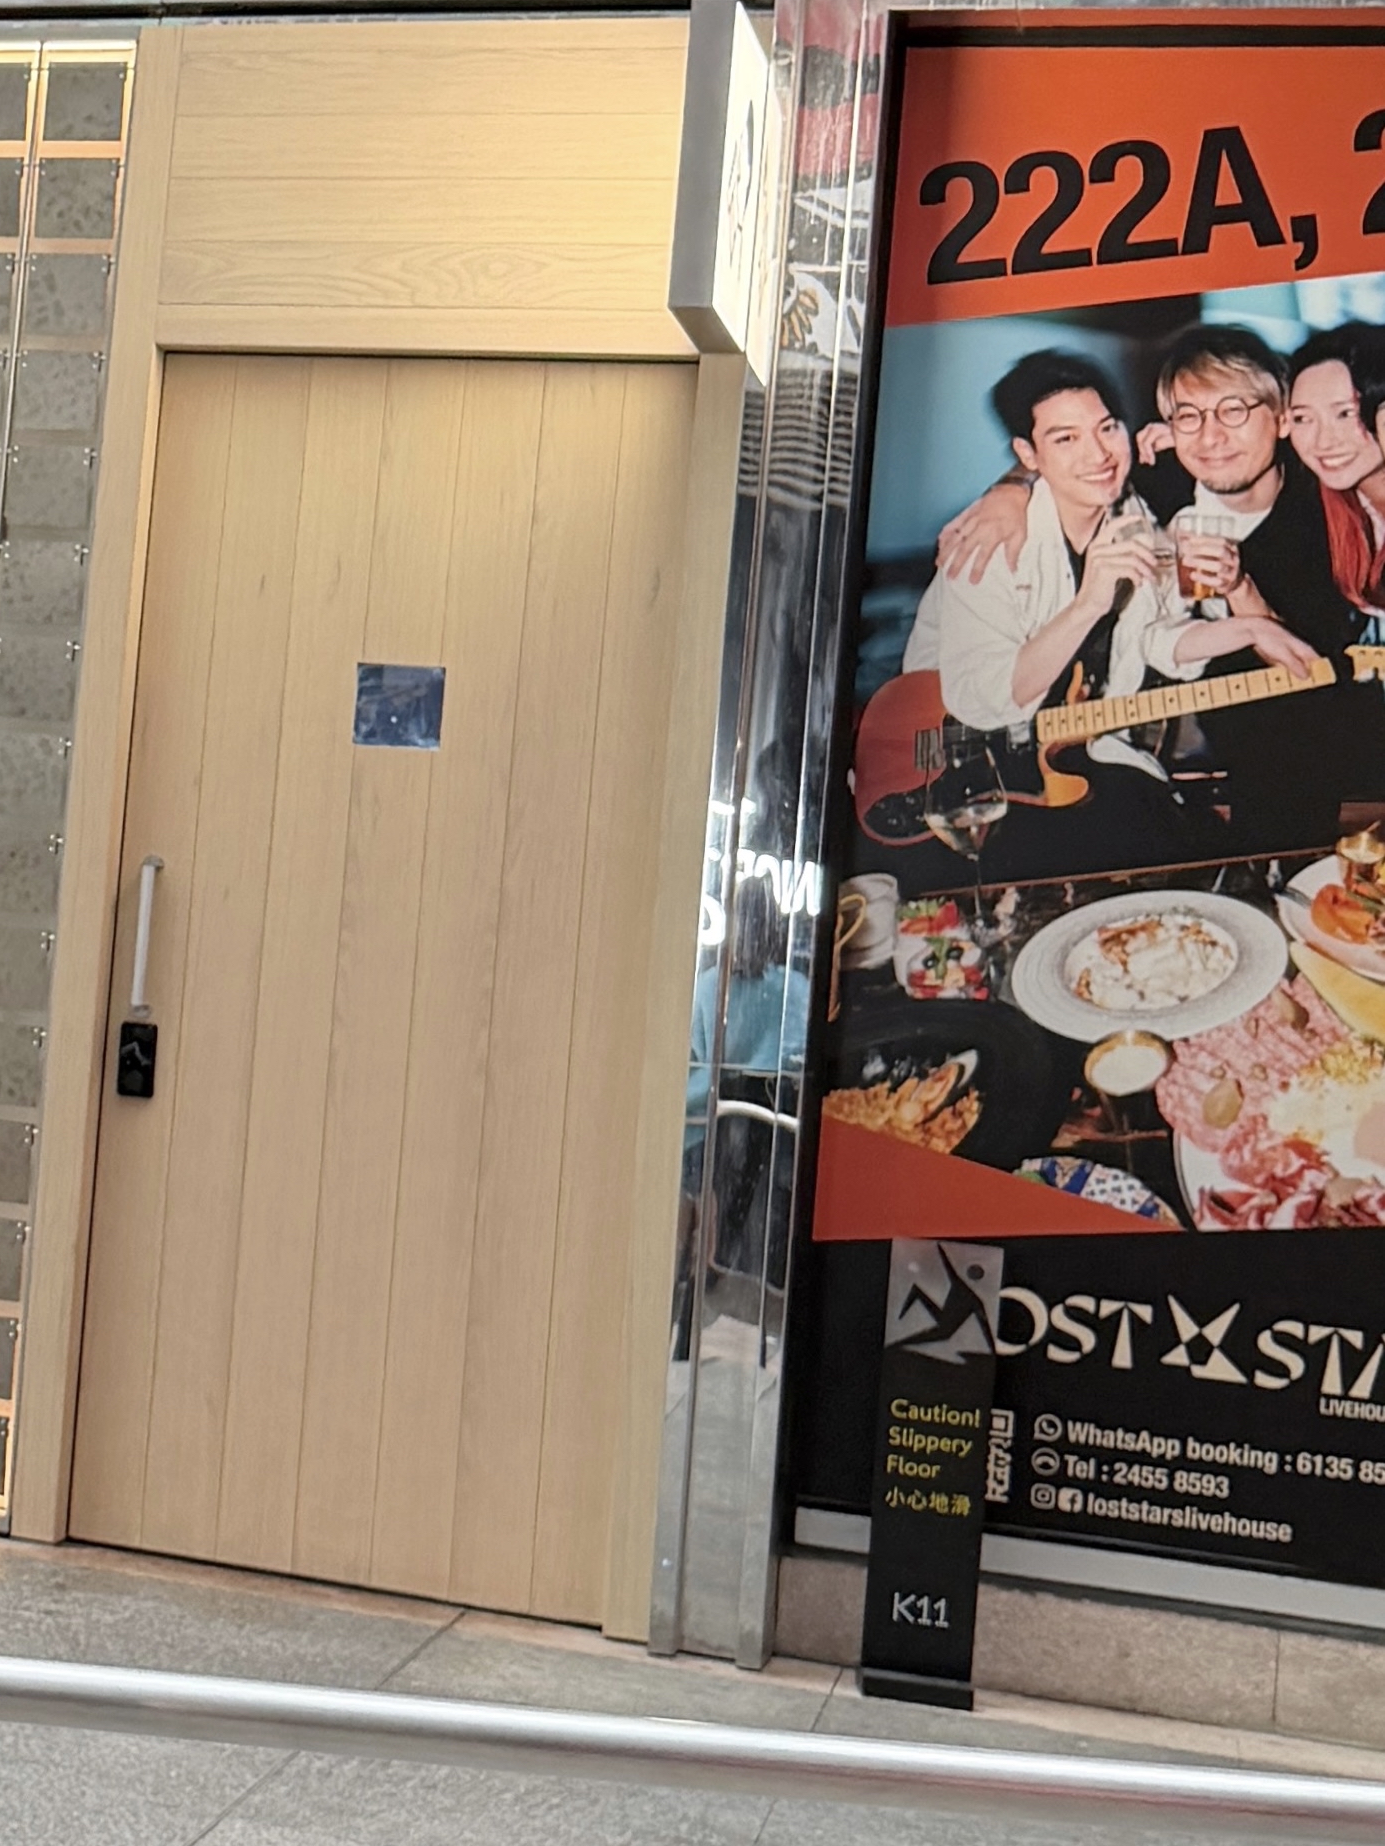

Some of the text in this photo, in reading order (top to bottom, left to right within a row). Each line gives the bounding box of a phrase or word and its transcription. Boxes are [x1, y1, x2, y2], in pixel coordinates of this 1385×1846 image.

[919, 126, 1319, 285] 222A,
[994, 1286, 1154, 1370] OST
[890, 1398, 981, 1428] Caution!
[887, 1426, 973, 1457] Slippery
[1066, 1419, 1182, 1460] WhatsApp
[1186, 1436, 1279, 1475] booking
[1296, 1452, 1354, 1481] 6135
[886, 1453, 941, 1478] Floor
[1063, 1455, 1096, 1480] Tel
[1112, 1462, 1169, 1490] 2455
[1172, 1470, 1230, 1499] 8593
[885, 1485, 972, 1517] 小心地滑
[1087, 1493, 1293, 1543] loststarslivehouse
[892, 1591, 950, 1629] K11
